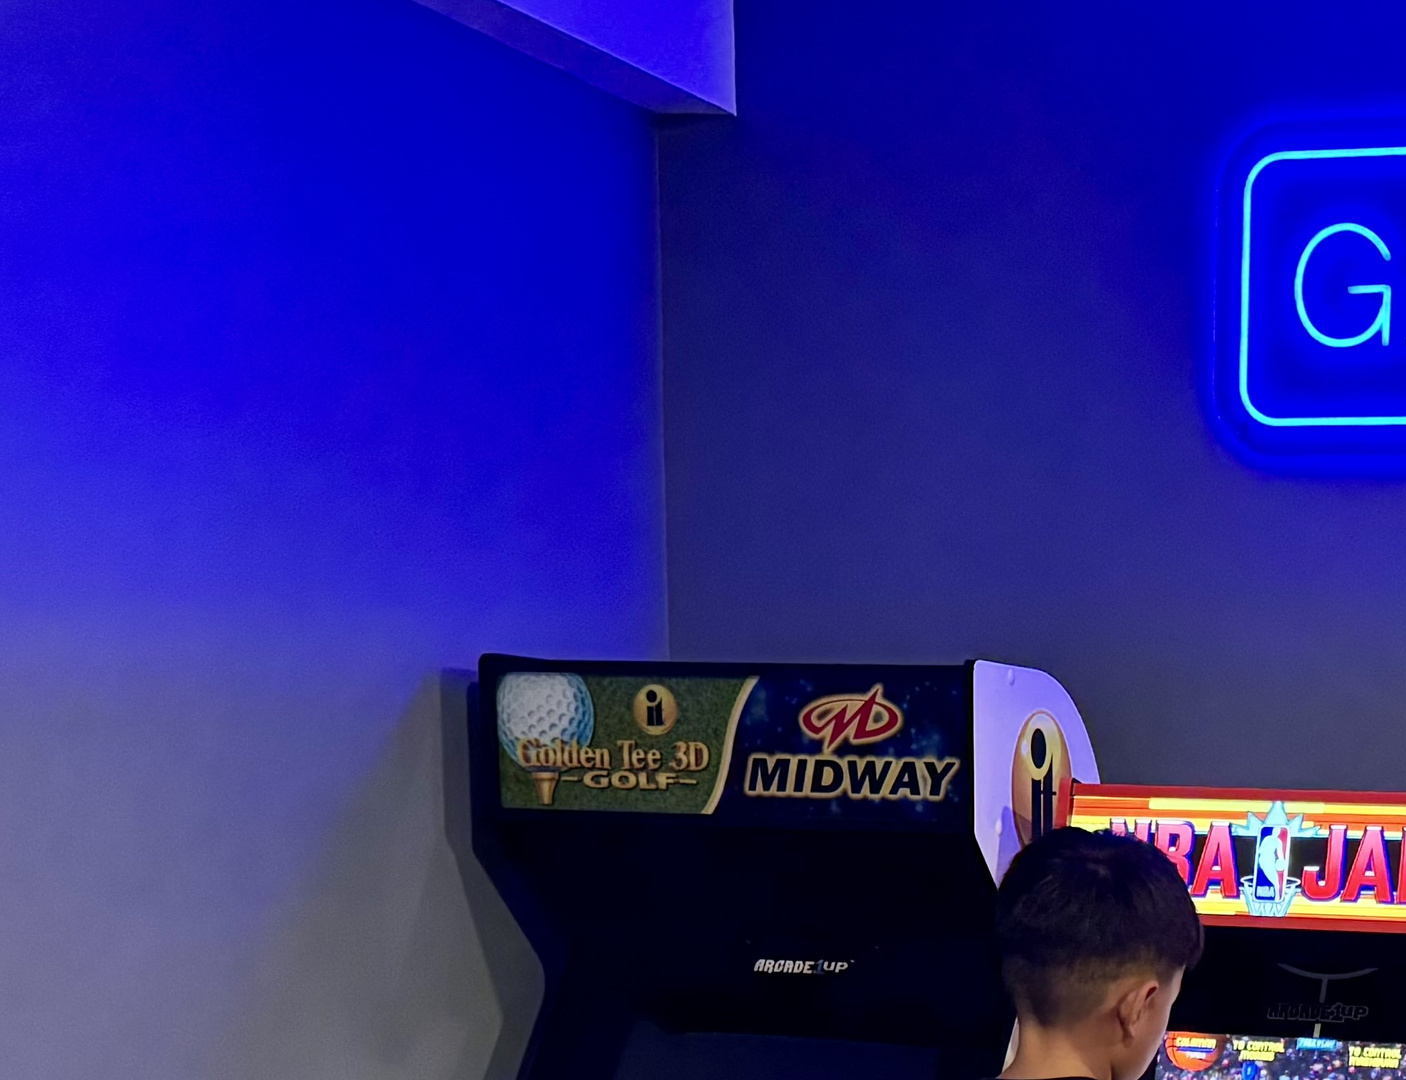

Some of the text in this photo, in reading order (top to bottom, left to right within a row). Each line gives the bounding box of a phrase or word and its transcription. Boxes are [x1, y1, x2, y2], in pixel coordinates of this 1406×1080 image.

[517, 737, 710, 772] Golden Tee 3D
[582, 770, 678, 791] GOLF
[746, 756, 957, 799] MIDWAY
[1110, 818, 1240, 900] BA
